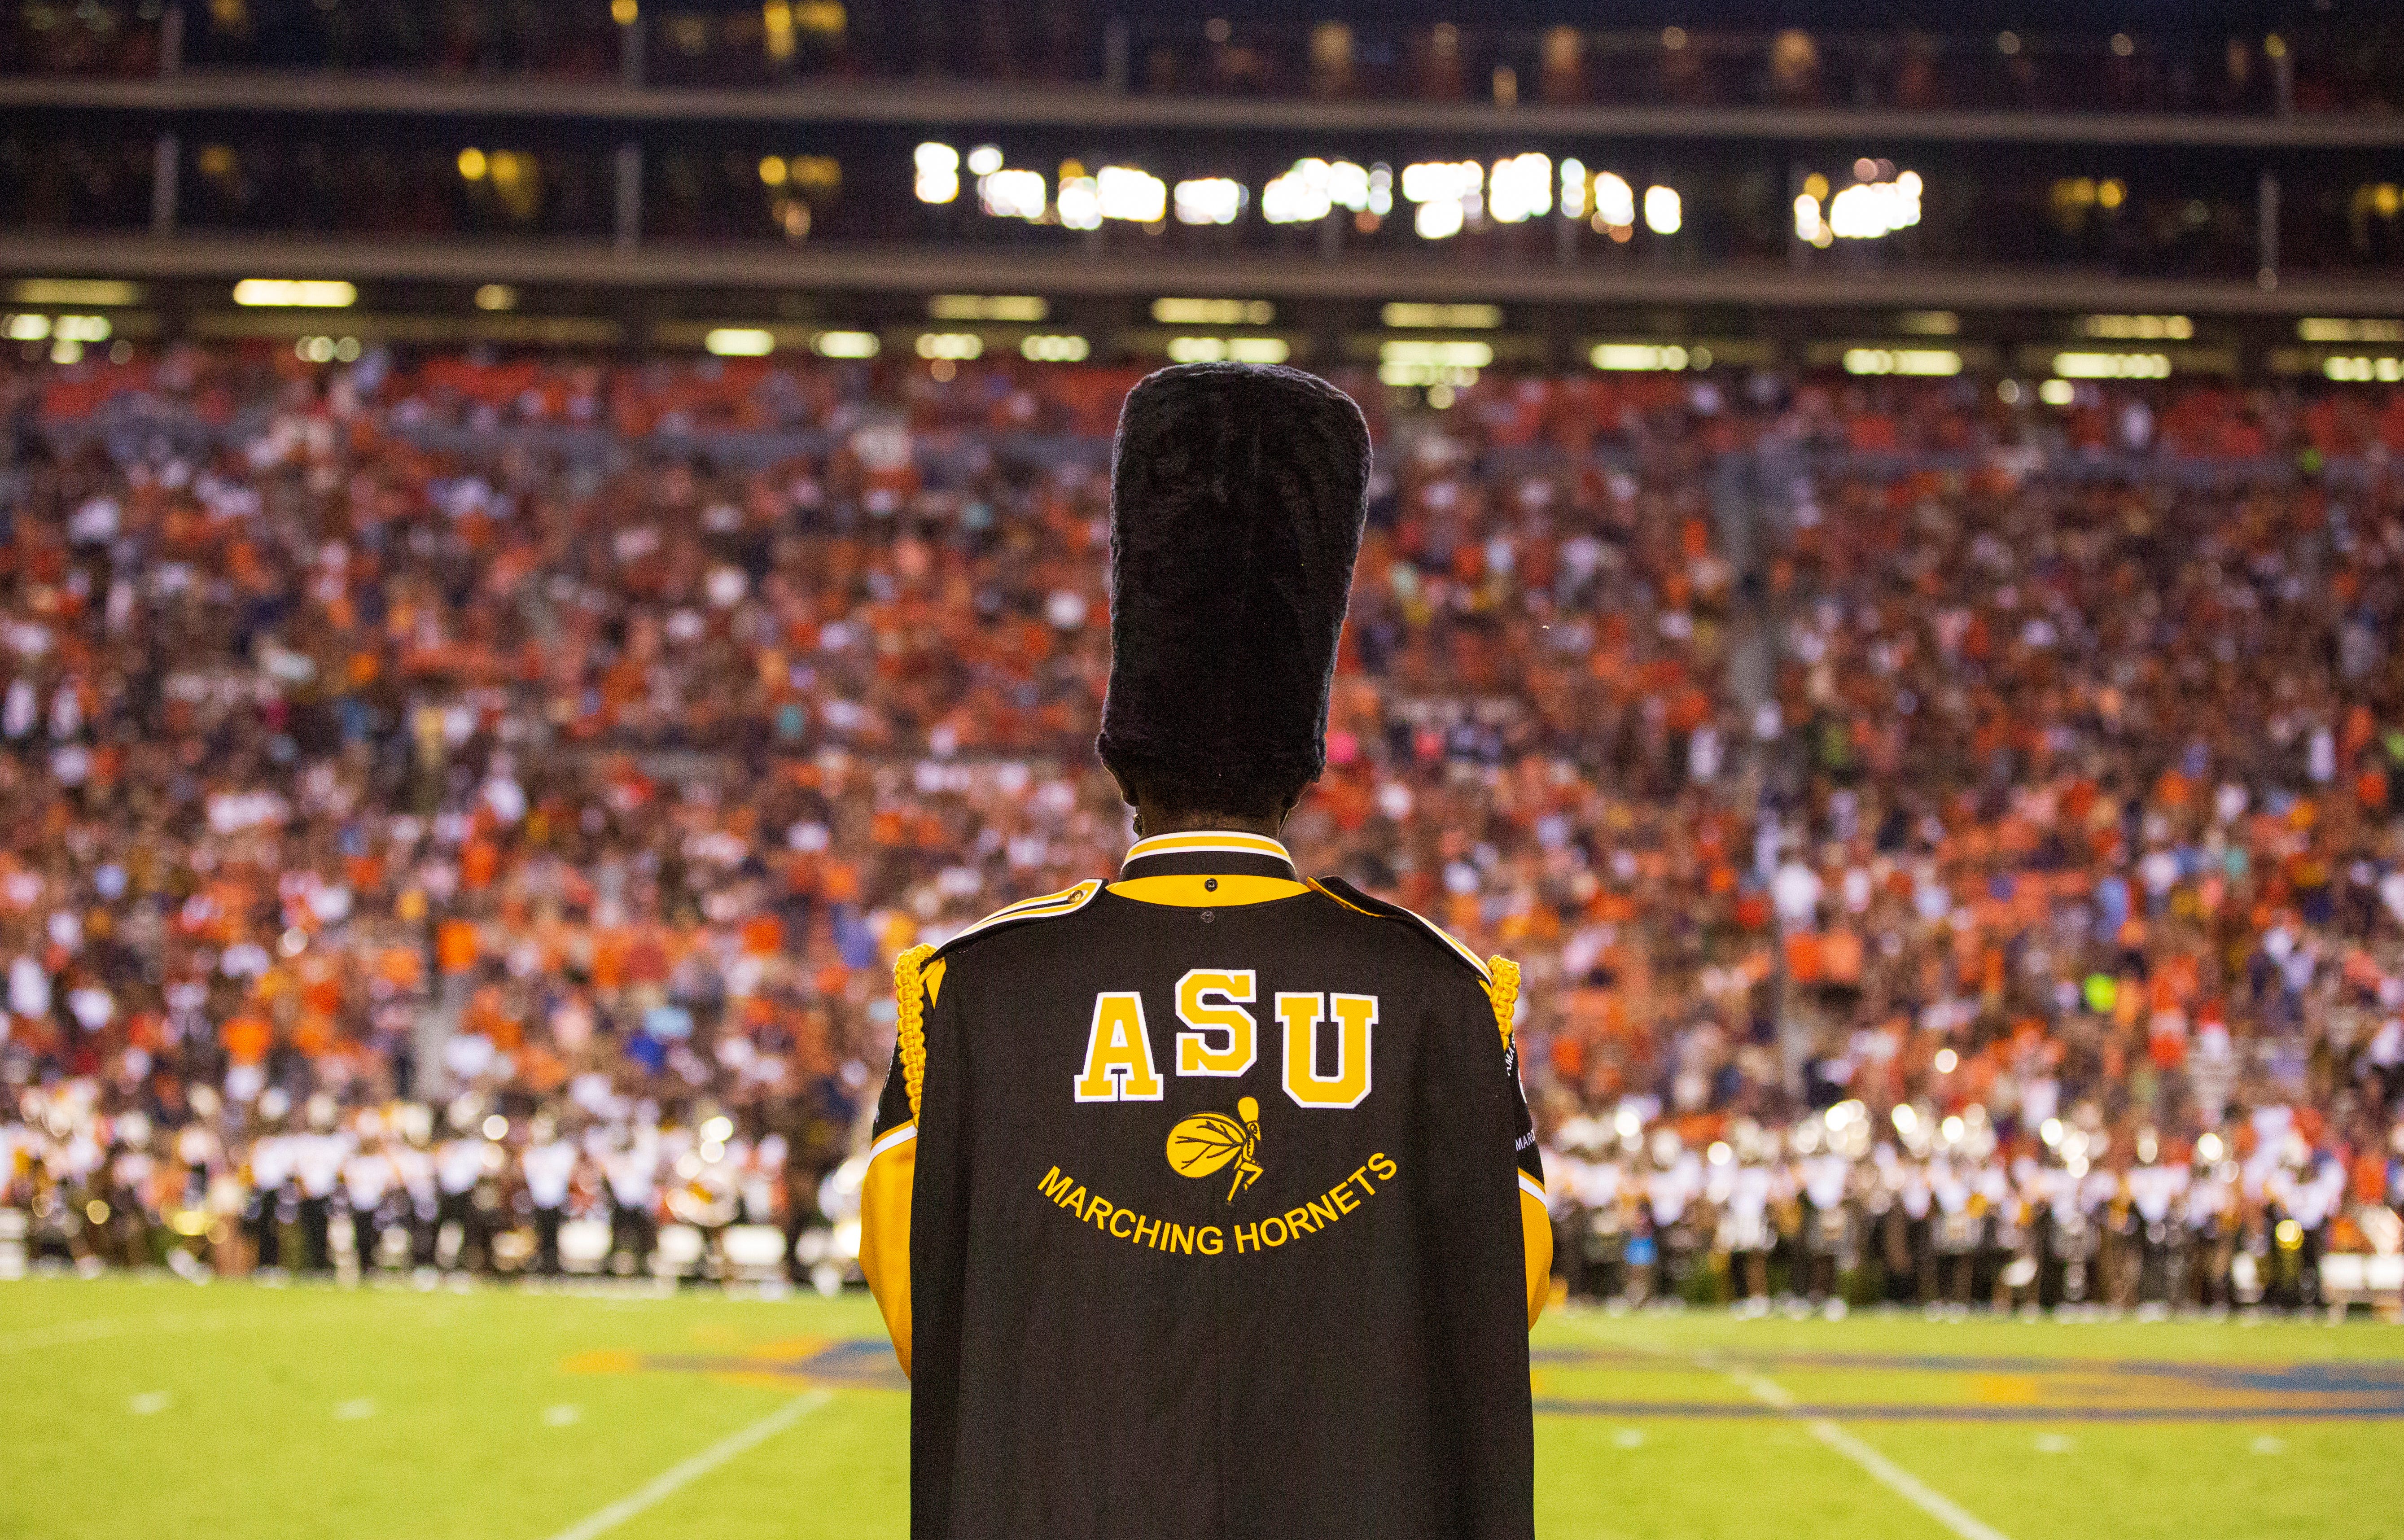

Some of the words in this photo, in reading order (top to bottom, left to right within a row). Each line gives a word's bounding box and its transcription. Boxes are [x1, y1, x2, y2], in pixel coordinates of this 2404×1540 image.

[1074, 968, 1379, 1109] ASU
[1037, 1165, 1223, 1255] MARCHING
[1234, 1152, 1397, 1254] HORNETS
